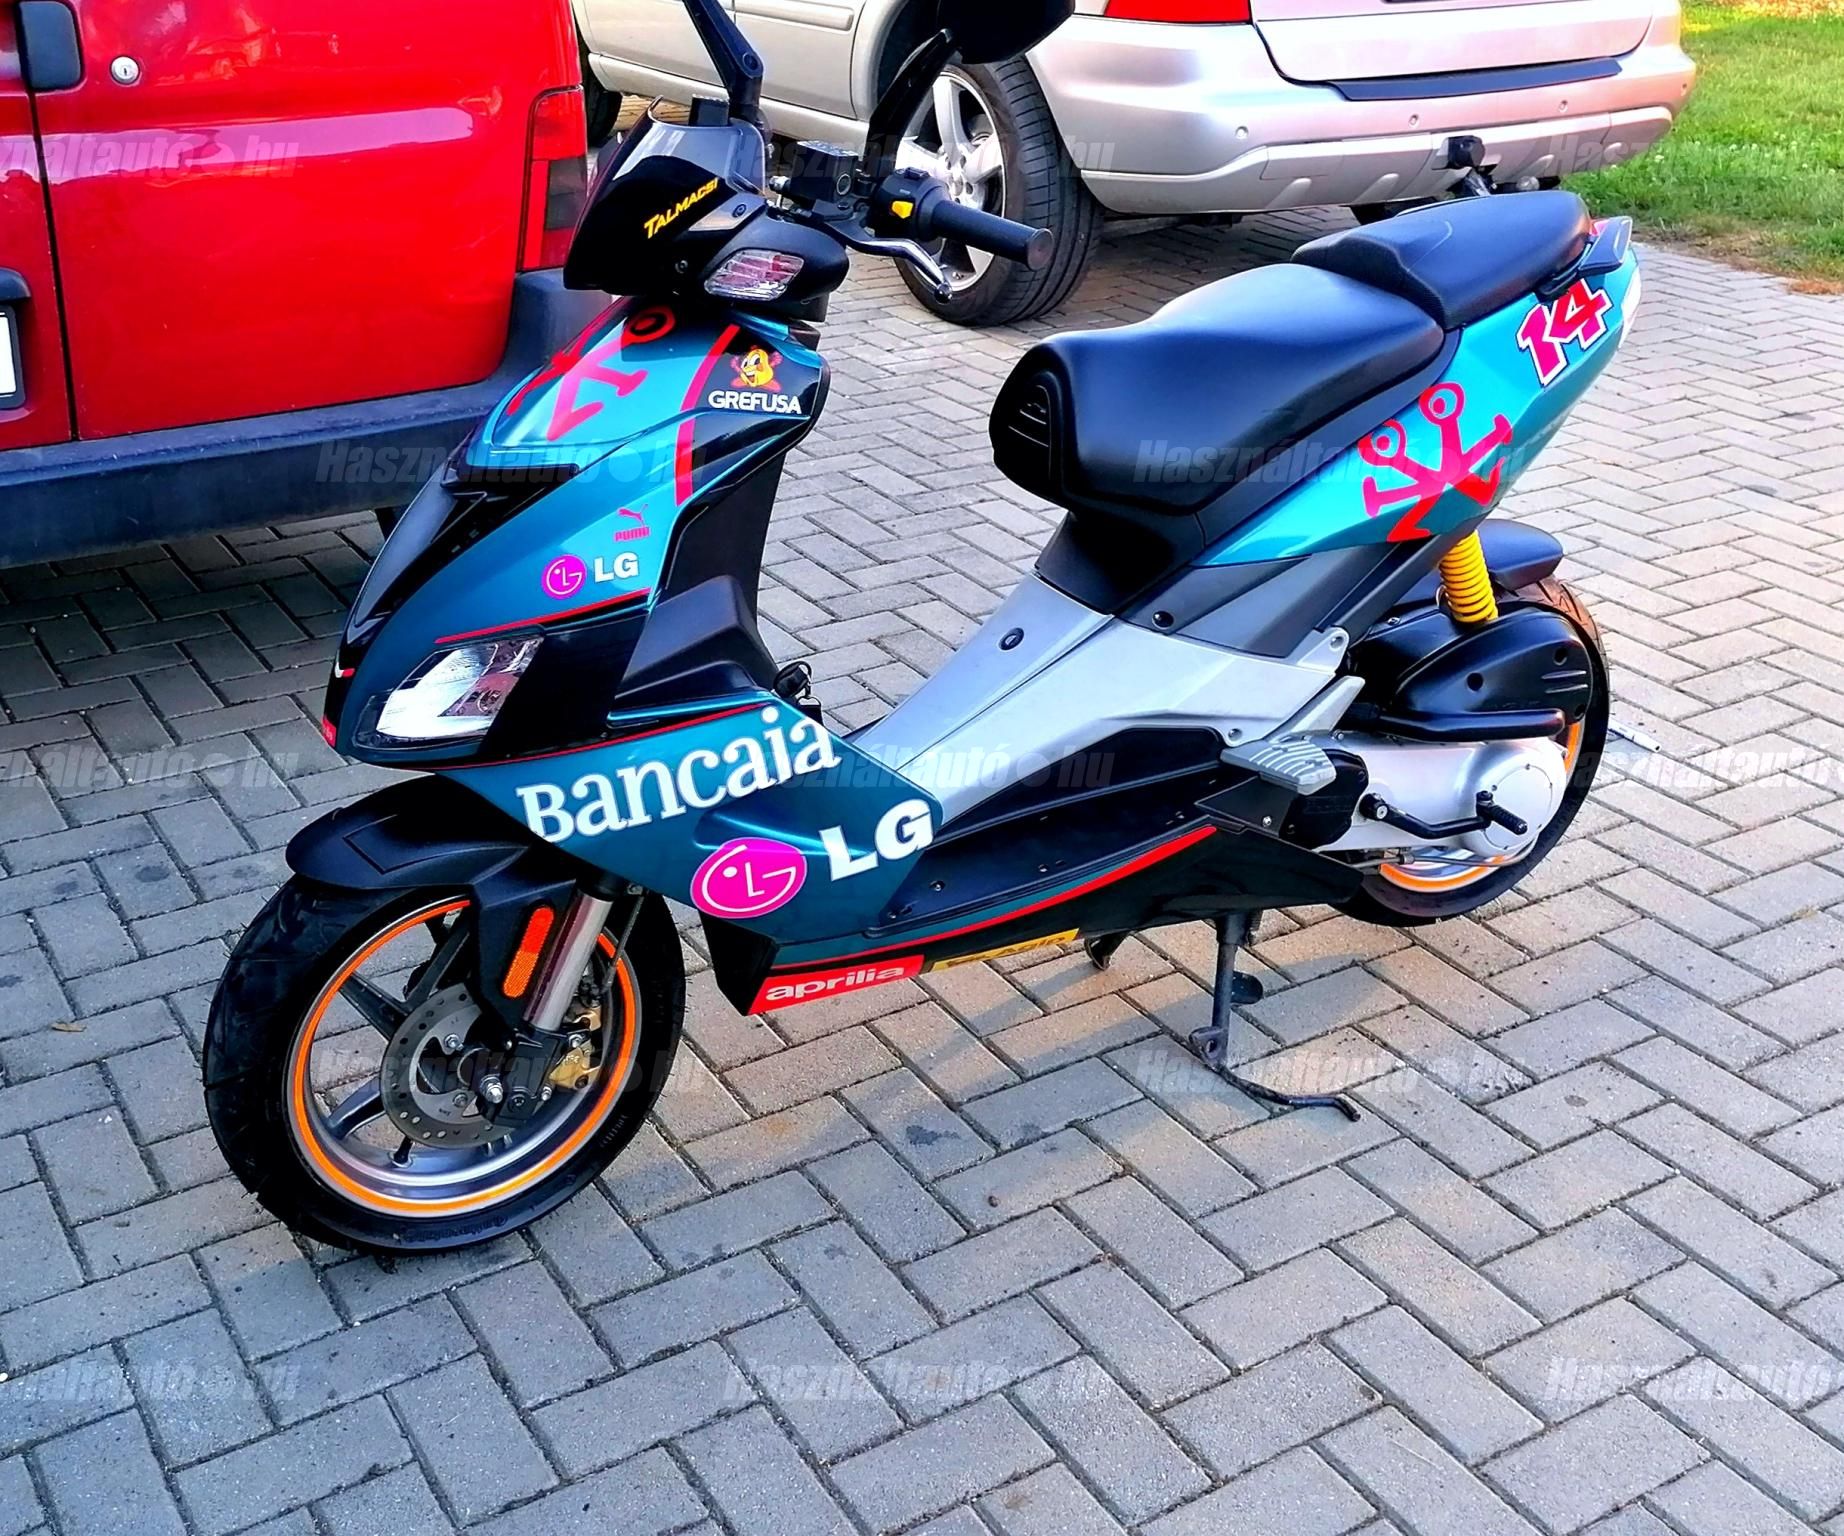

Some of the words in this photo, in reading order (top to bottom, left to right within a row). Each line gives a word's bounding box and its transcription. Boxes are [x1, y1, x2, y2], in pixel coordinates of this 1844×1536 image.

[644, 177, 719, 239] TALMACSI
[1516, 278, 1613, 387] 14
[708, 390, 802, 414] GREFUSA
[594, 552, 639, 582] LG
[819, 799, 933, 881] LG
[766, 967, 904, 1001] aprilia
